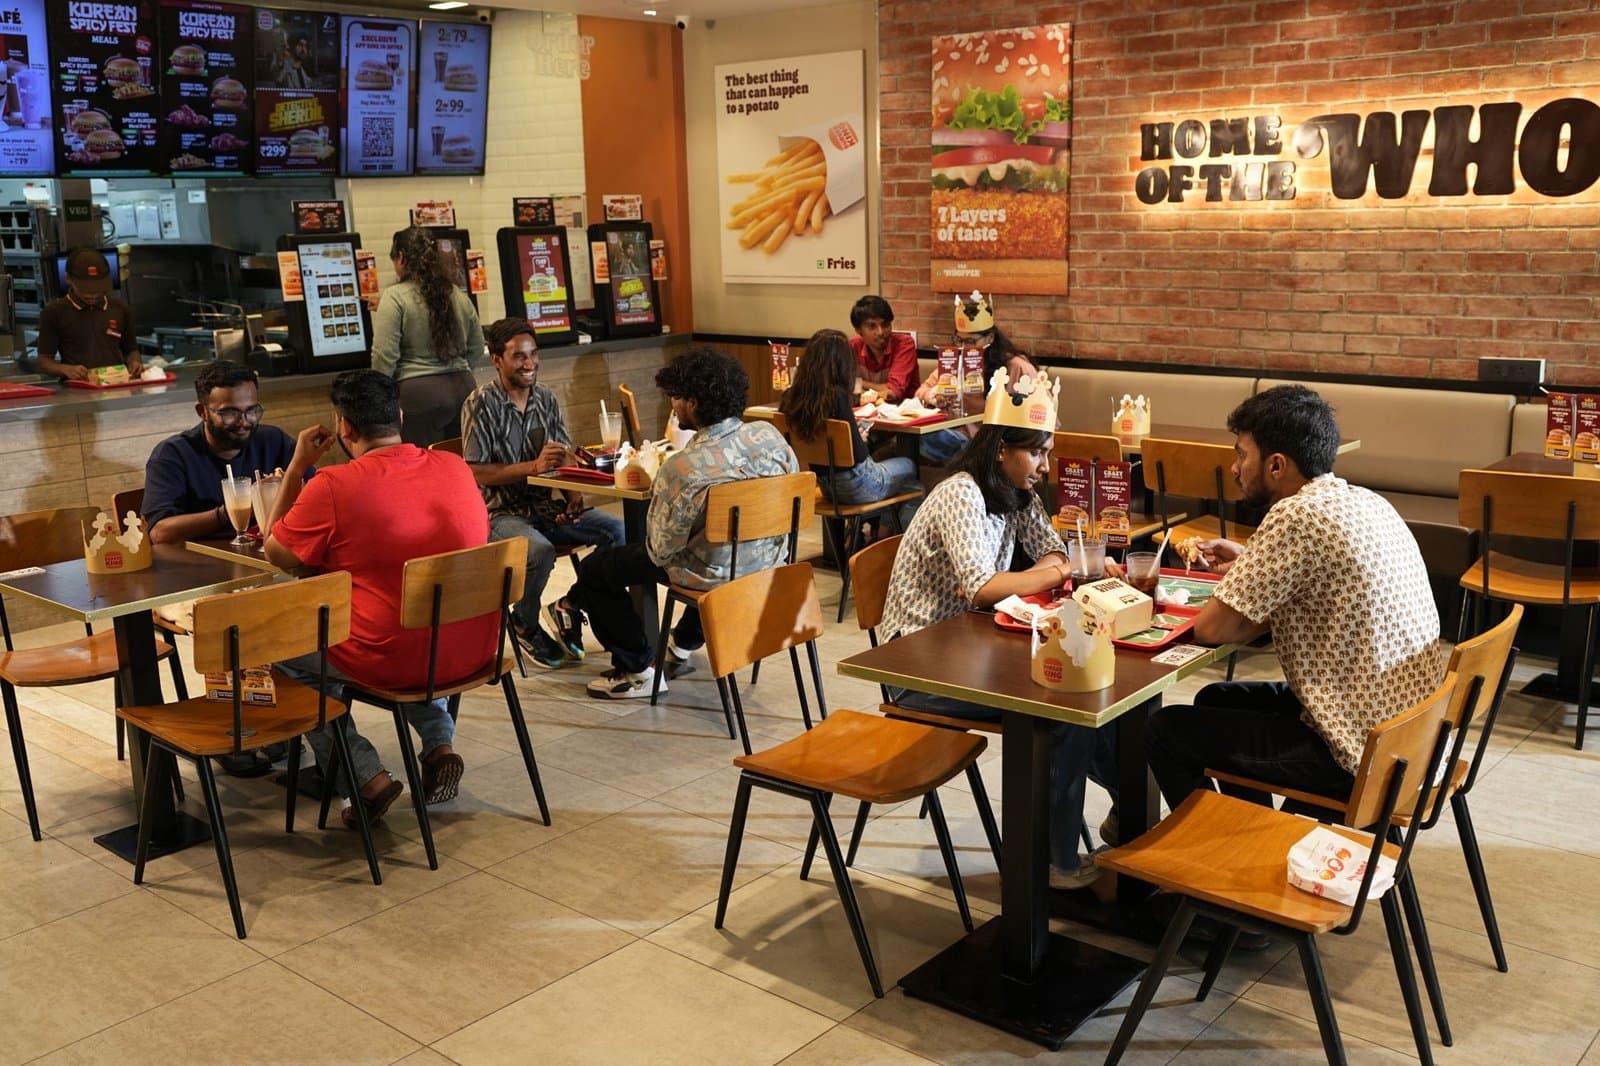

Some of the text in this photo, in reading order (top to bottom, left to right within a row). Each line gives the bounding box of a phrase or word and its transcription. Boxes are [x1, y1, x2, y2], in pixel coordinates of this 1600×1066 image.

[68, 1, 137, 21] KOREAN
[70, 17, 137, 34] SPICY FEST
[179, 11, 236, 29] KOREAN
[91, 34, 119, 45] MEALS
[179, 26, 235, 40] SPICY FEST
[725, 69, 799, 87] The best thing
[726, 85, 809, 100] that can happen
[726, 100, 779, 116] to a potato
[1140, 115, 1283, 162] HOME
[1135, 161, 1297, 204] OF THE
[938, 206, 1007, 226] 7 Layers
[937, 224, 998, 241] of taste
[827, 256, 856, 270] Fries
